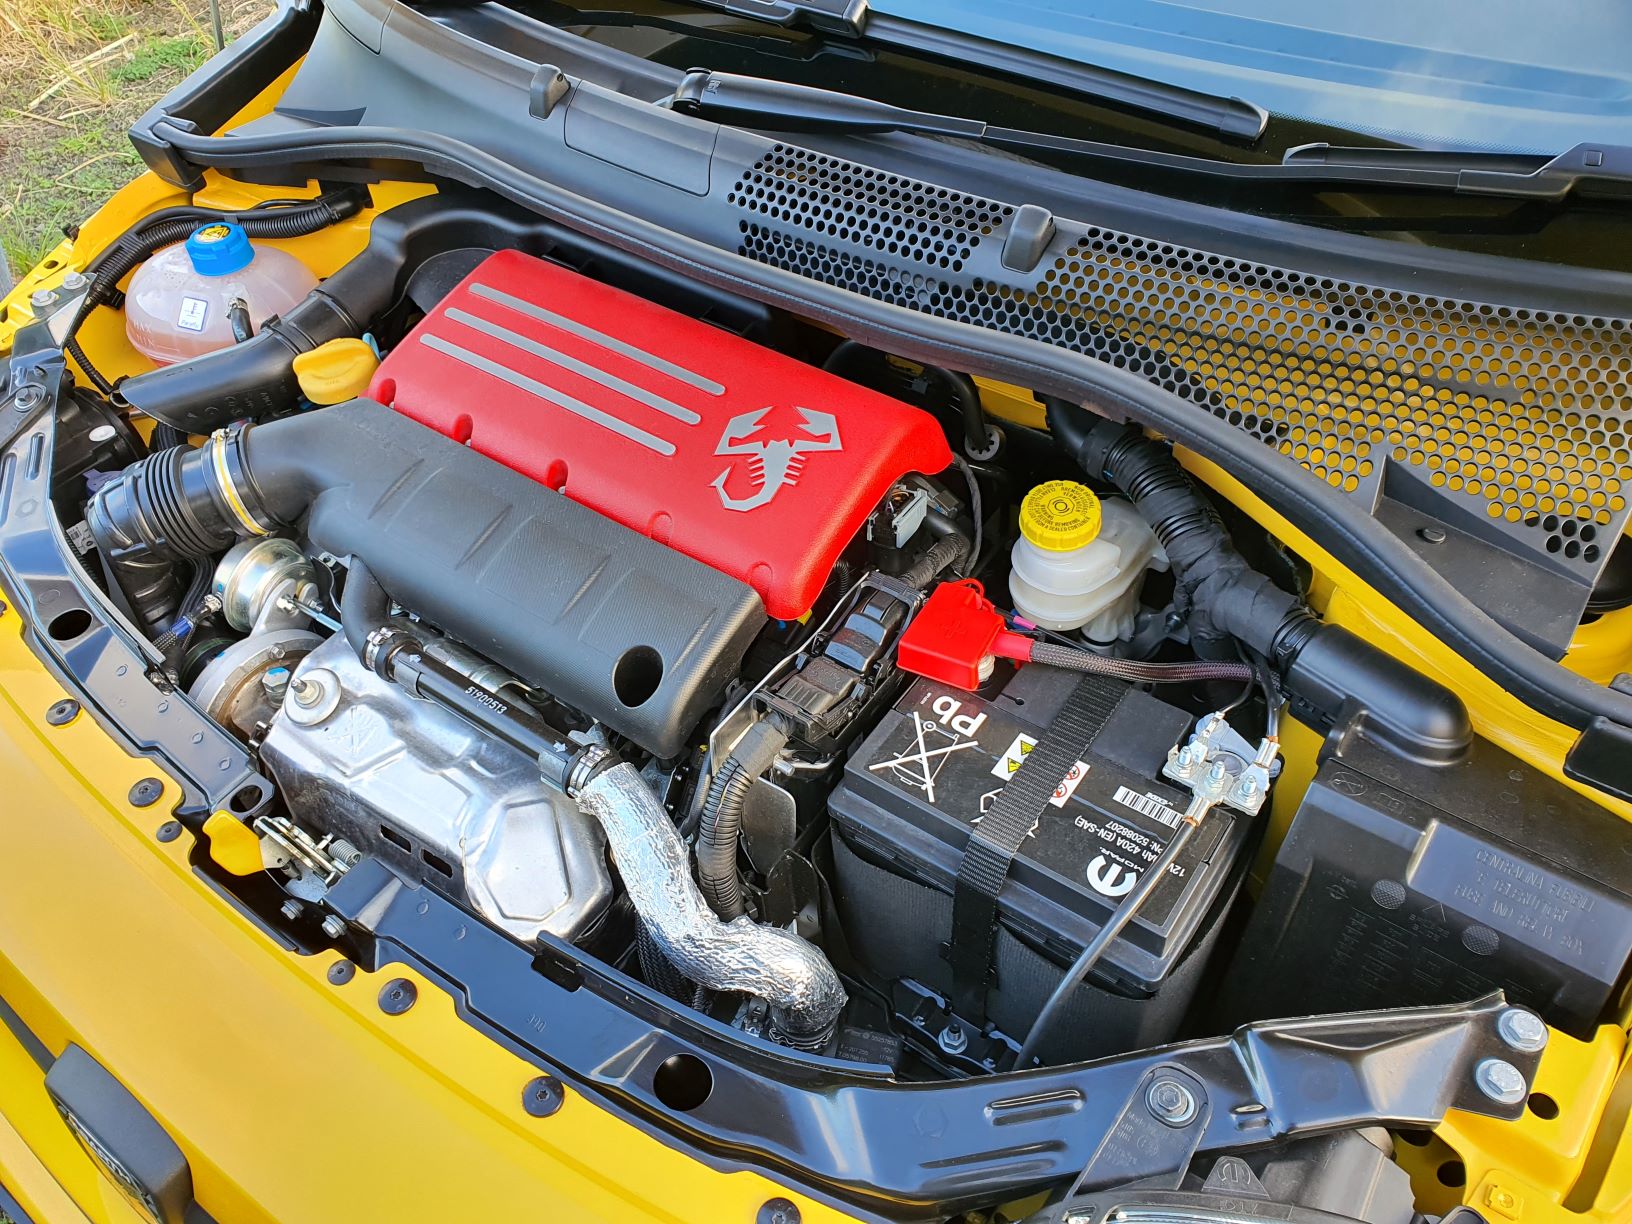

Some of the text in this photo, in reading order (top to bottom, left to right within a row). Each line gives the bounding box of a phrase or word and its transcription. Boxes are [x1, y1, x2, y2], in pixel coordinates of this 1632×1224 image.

[465, 686, 508, 715] 51900513
[932, 694, 987, 738] Pb
[1073, 814, 1116, 842] (EN-SAE)
[1105, 819, 1149, 846] 52088207
[1114, 836, 1142, 855] 420A
